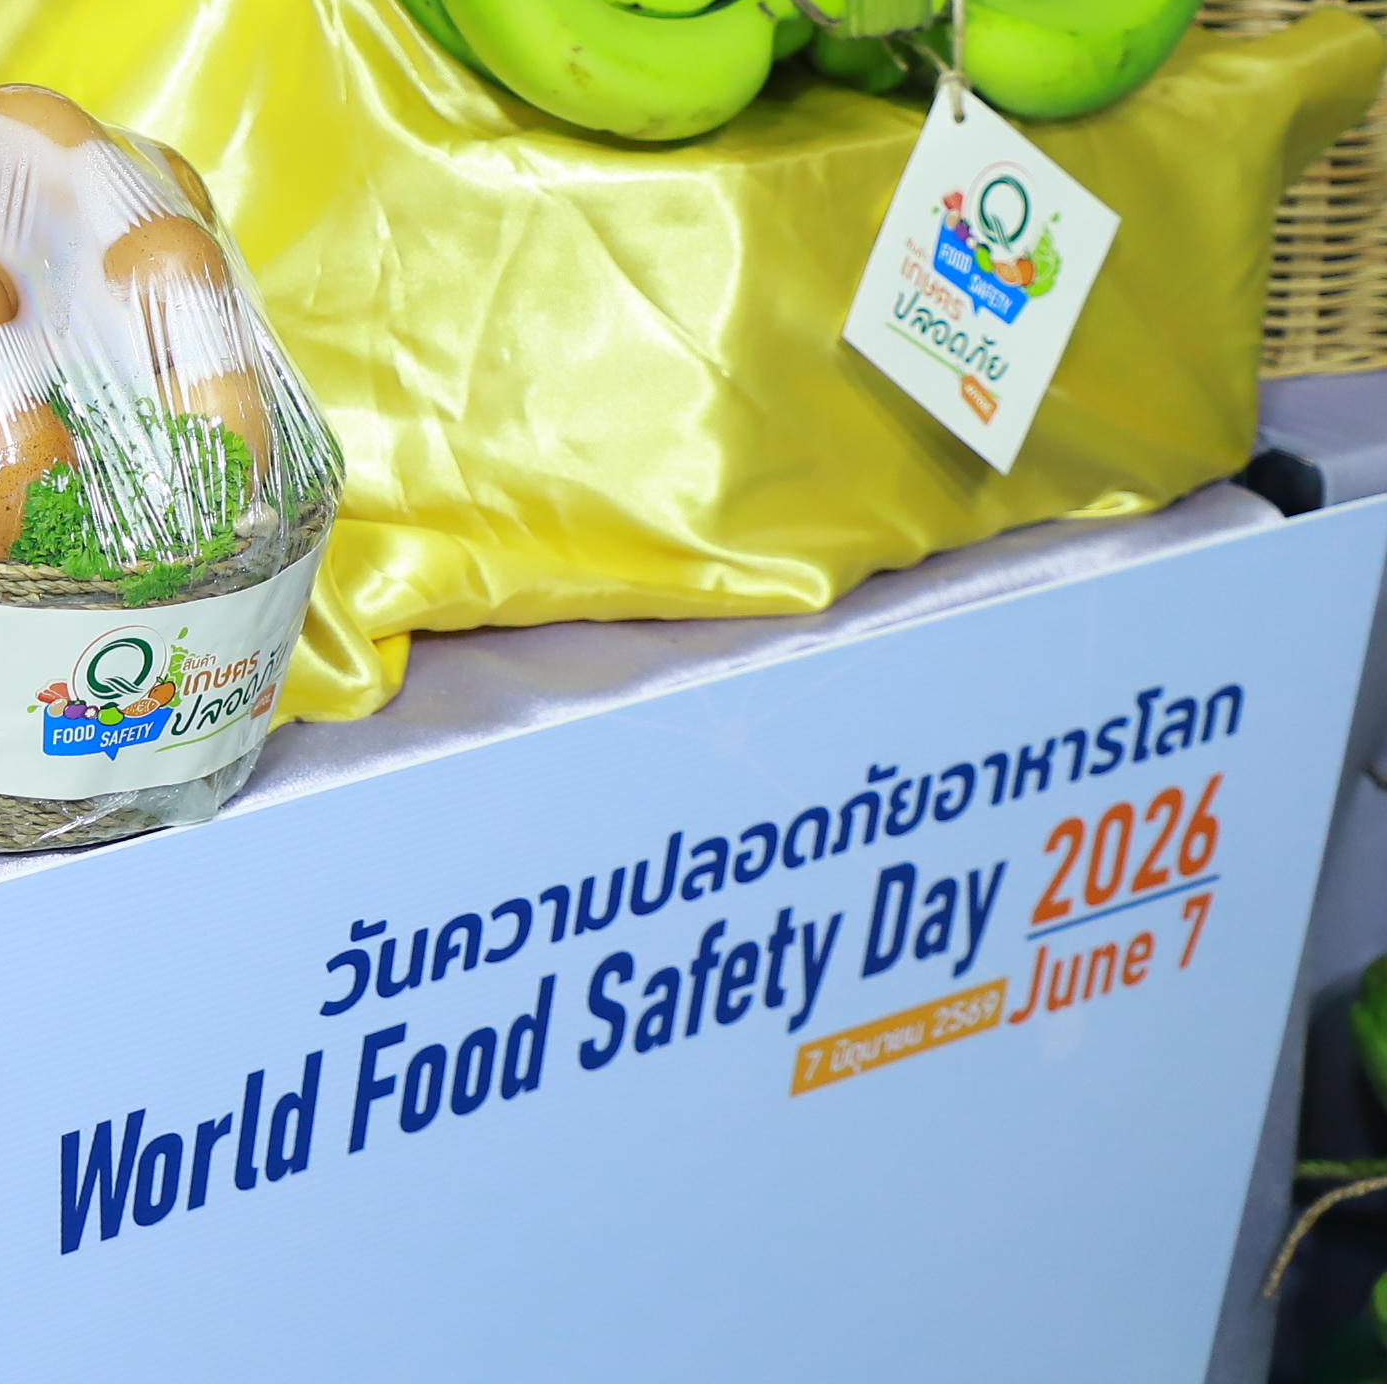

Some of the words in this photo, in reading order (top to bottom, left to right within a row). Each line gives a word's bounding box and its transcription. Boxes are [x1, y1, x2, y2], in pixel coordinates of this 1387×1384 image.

[979, 175, 1029, 252] Q
[937, 242, 973, 274] FOOD
[893, 290, 1011, 381] ปลอดภัย
[87, 637, 153, 701] Q
[182, 653, 217, 672] สินค้า
[183, 649, 261, 696] เกษตร
[52, 723, 96, 746] FOOD
[99, 720, 155, 748] SAFETY
[318, 682, 1244, 1017] วันความปลอดภัยอาหารโลก
[1007, 928, 1157, 1026] June
[1178, 890, 1213, 970] 7
[60, 1050, 323, 1257] World
[348, 974, 557, 1154] Food
[579, 907, 843, 1072] Safety
[860, 861, 1007, 979] Day
[1030, 773, 1224, 925] 2026
[804, 1048, 824, 1083] 7
[930, 989, 1001, 1040] 2569
